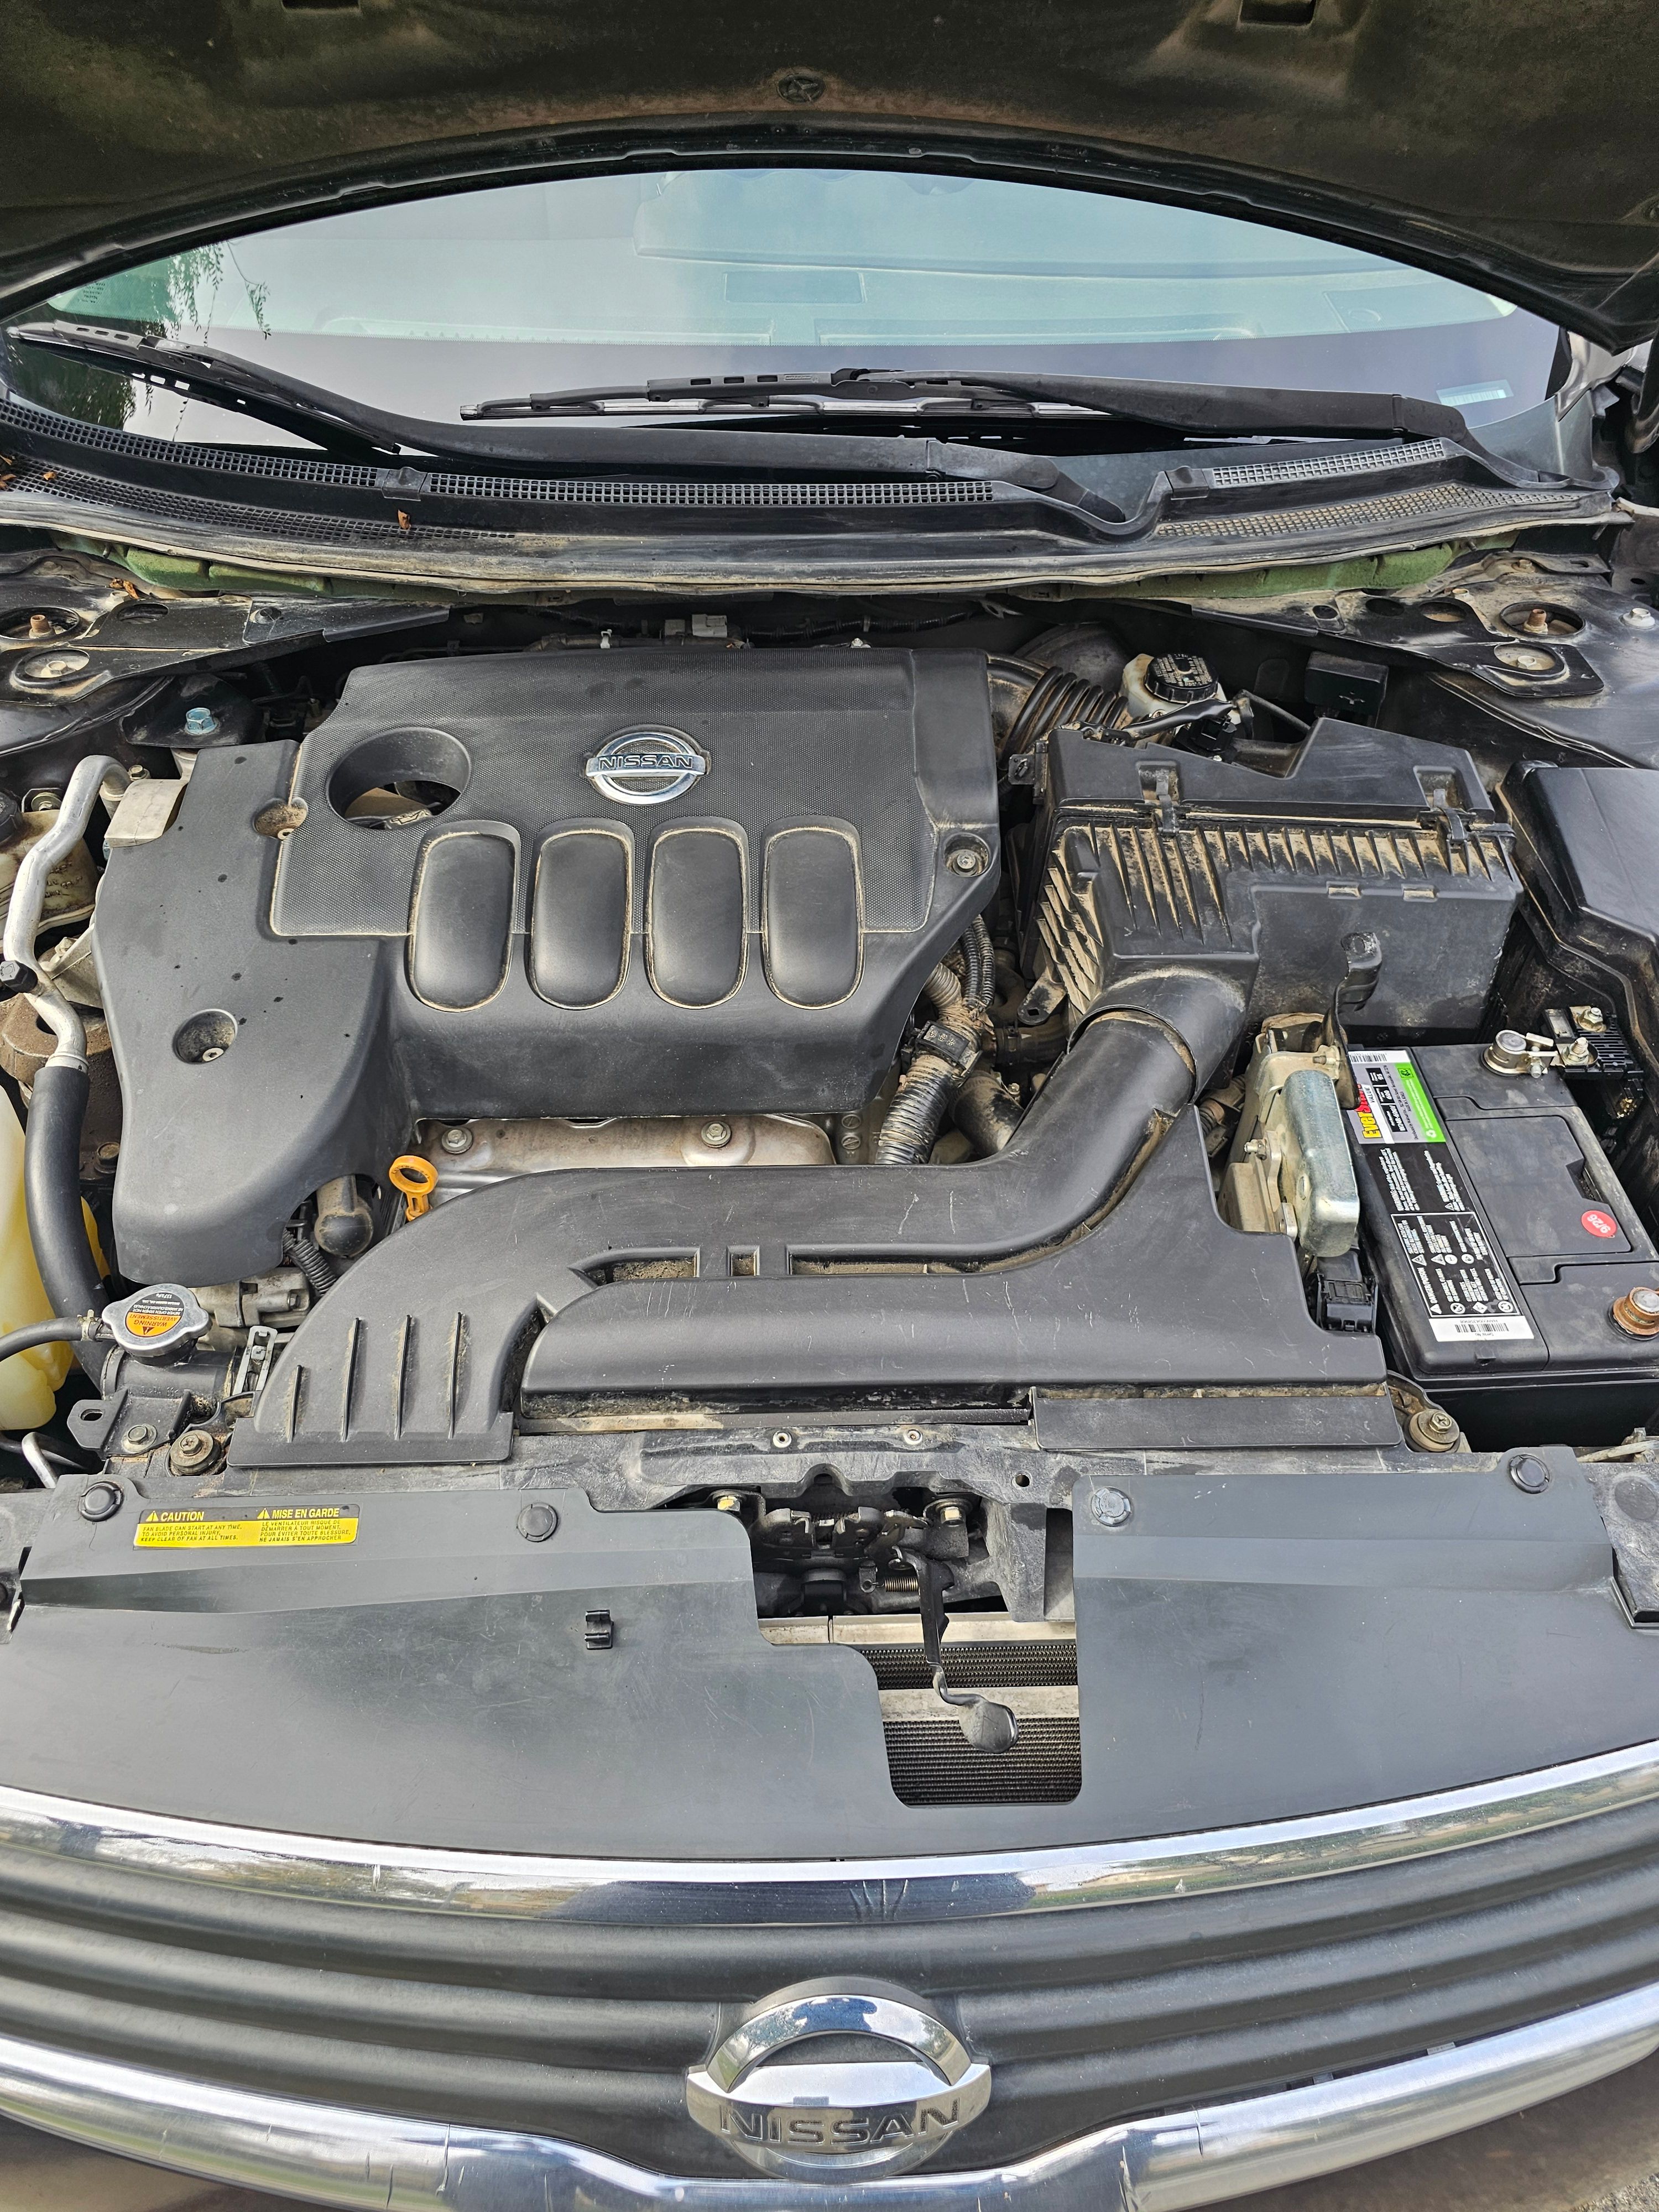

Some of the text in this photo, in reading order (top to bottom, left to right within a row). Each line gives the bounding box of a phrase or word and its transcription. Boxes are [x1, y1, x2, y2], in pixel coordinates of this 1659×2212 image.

[599, 754, 693, 769] NISSAN
[1364, 1087, 1375, 1103] VALUE
[1384, 1090, 1392, 1099] 600
[1416, 1267, 1438, 1303] DANGER/POISON
[161, 1511, 205, 1521] CAUTION
[272, 1508, 340, 1519] MISE EN GARDE
[720, 2098, 961, 2145] NISSAN
